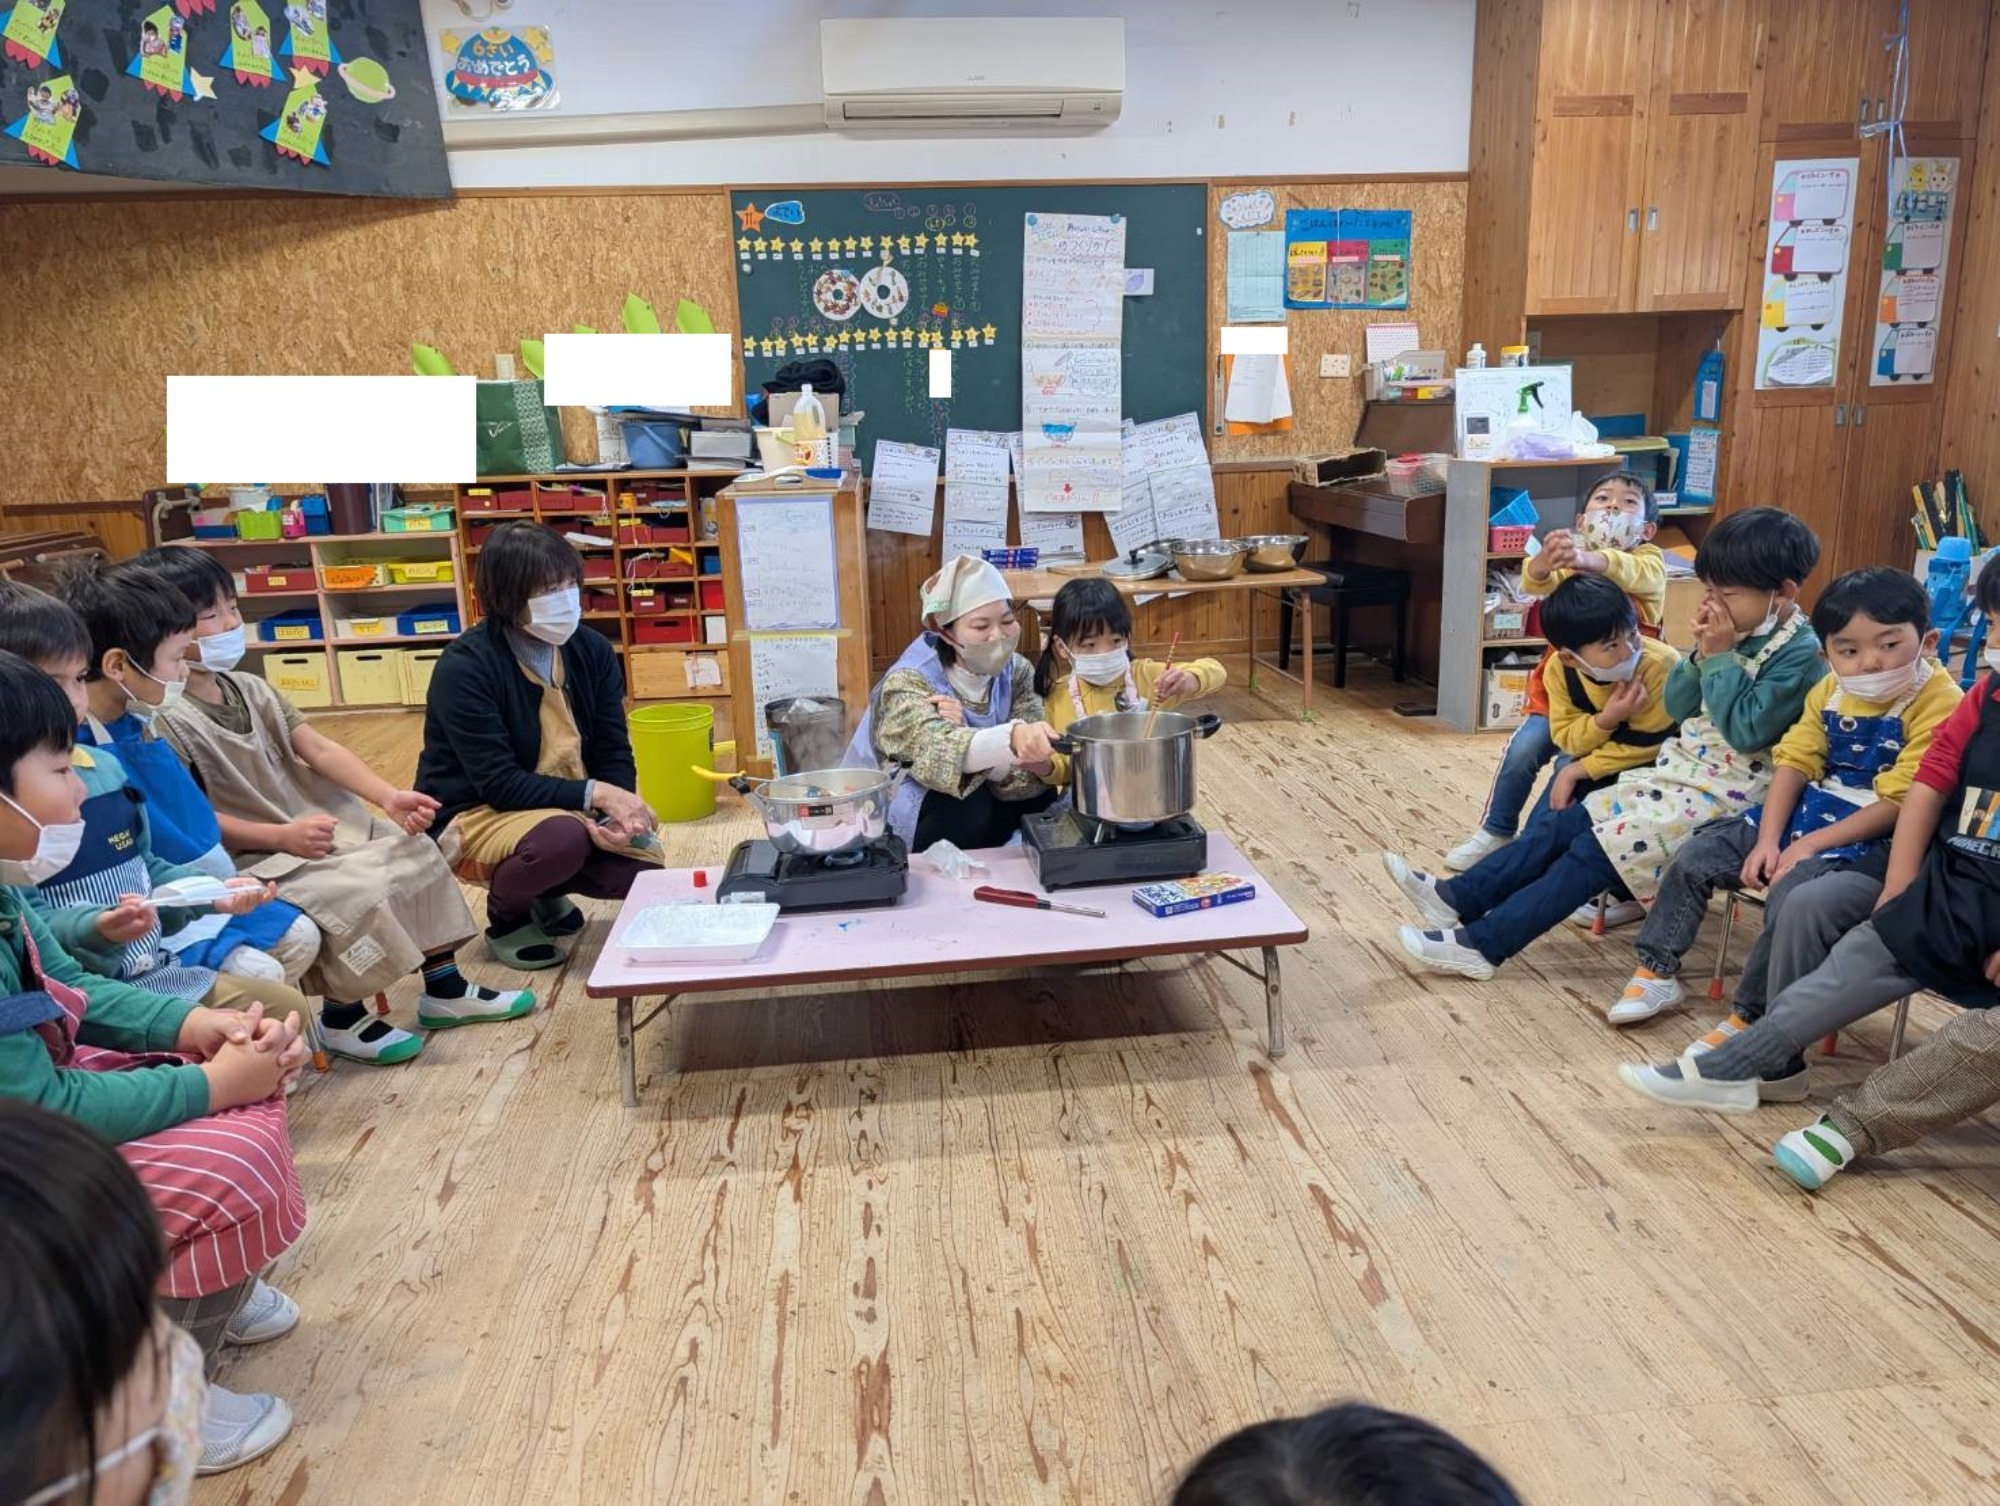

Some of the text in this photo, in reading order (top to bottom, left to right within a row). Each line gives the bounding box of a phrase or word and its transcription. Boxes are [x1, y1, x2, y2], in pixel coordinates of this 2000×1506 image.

[457, 54, 530, 76] おめでとう
